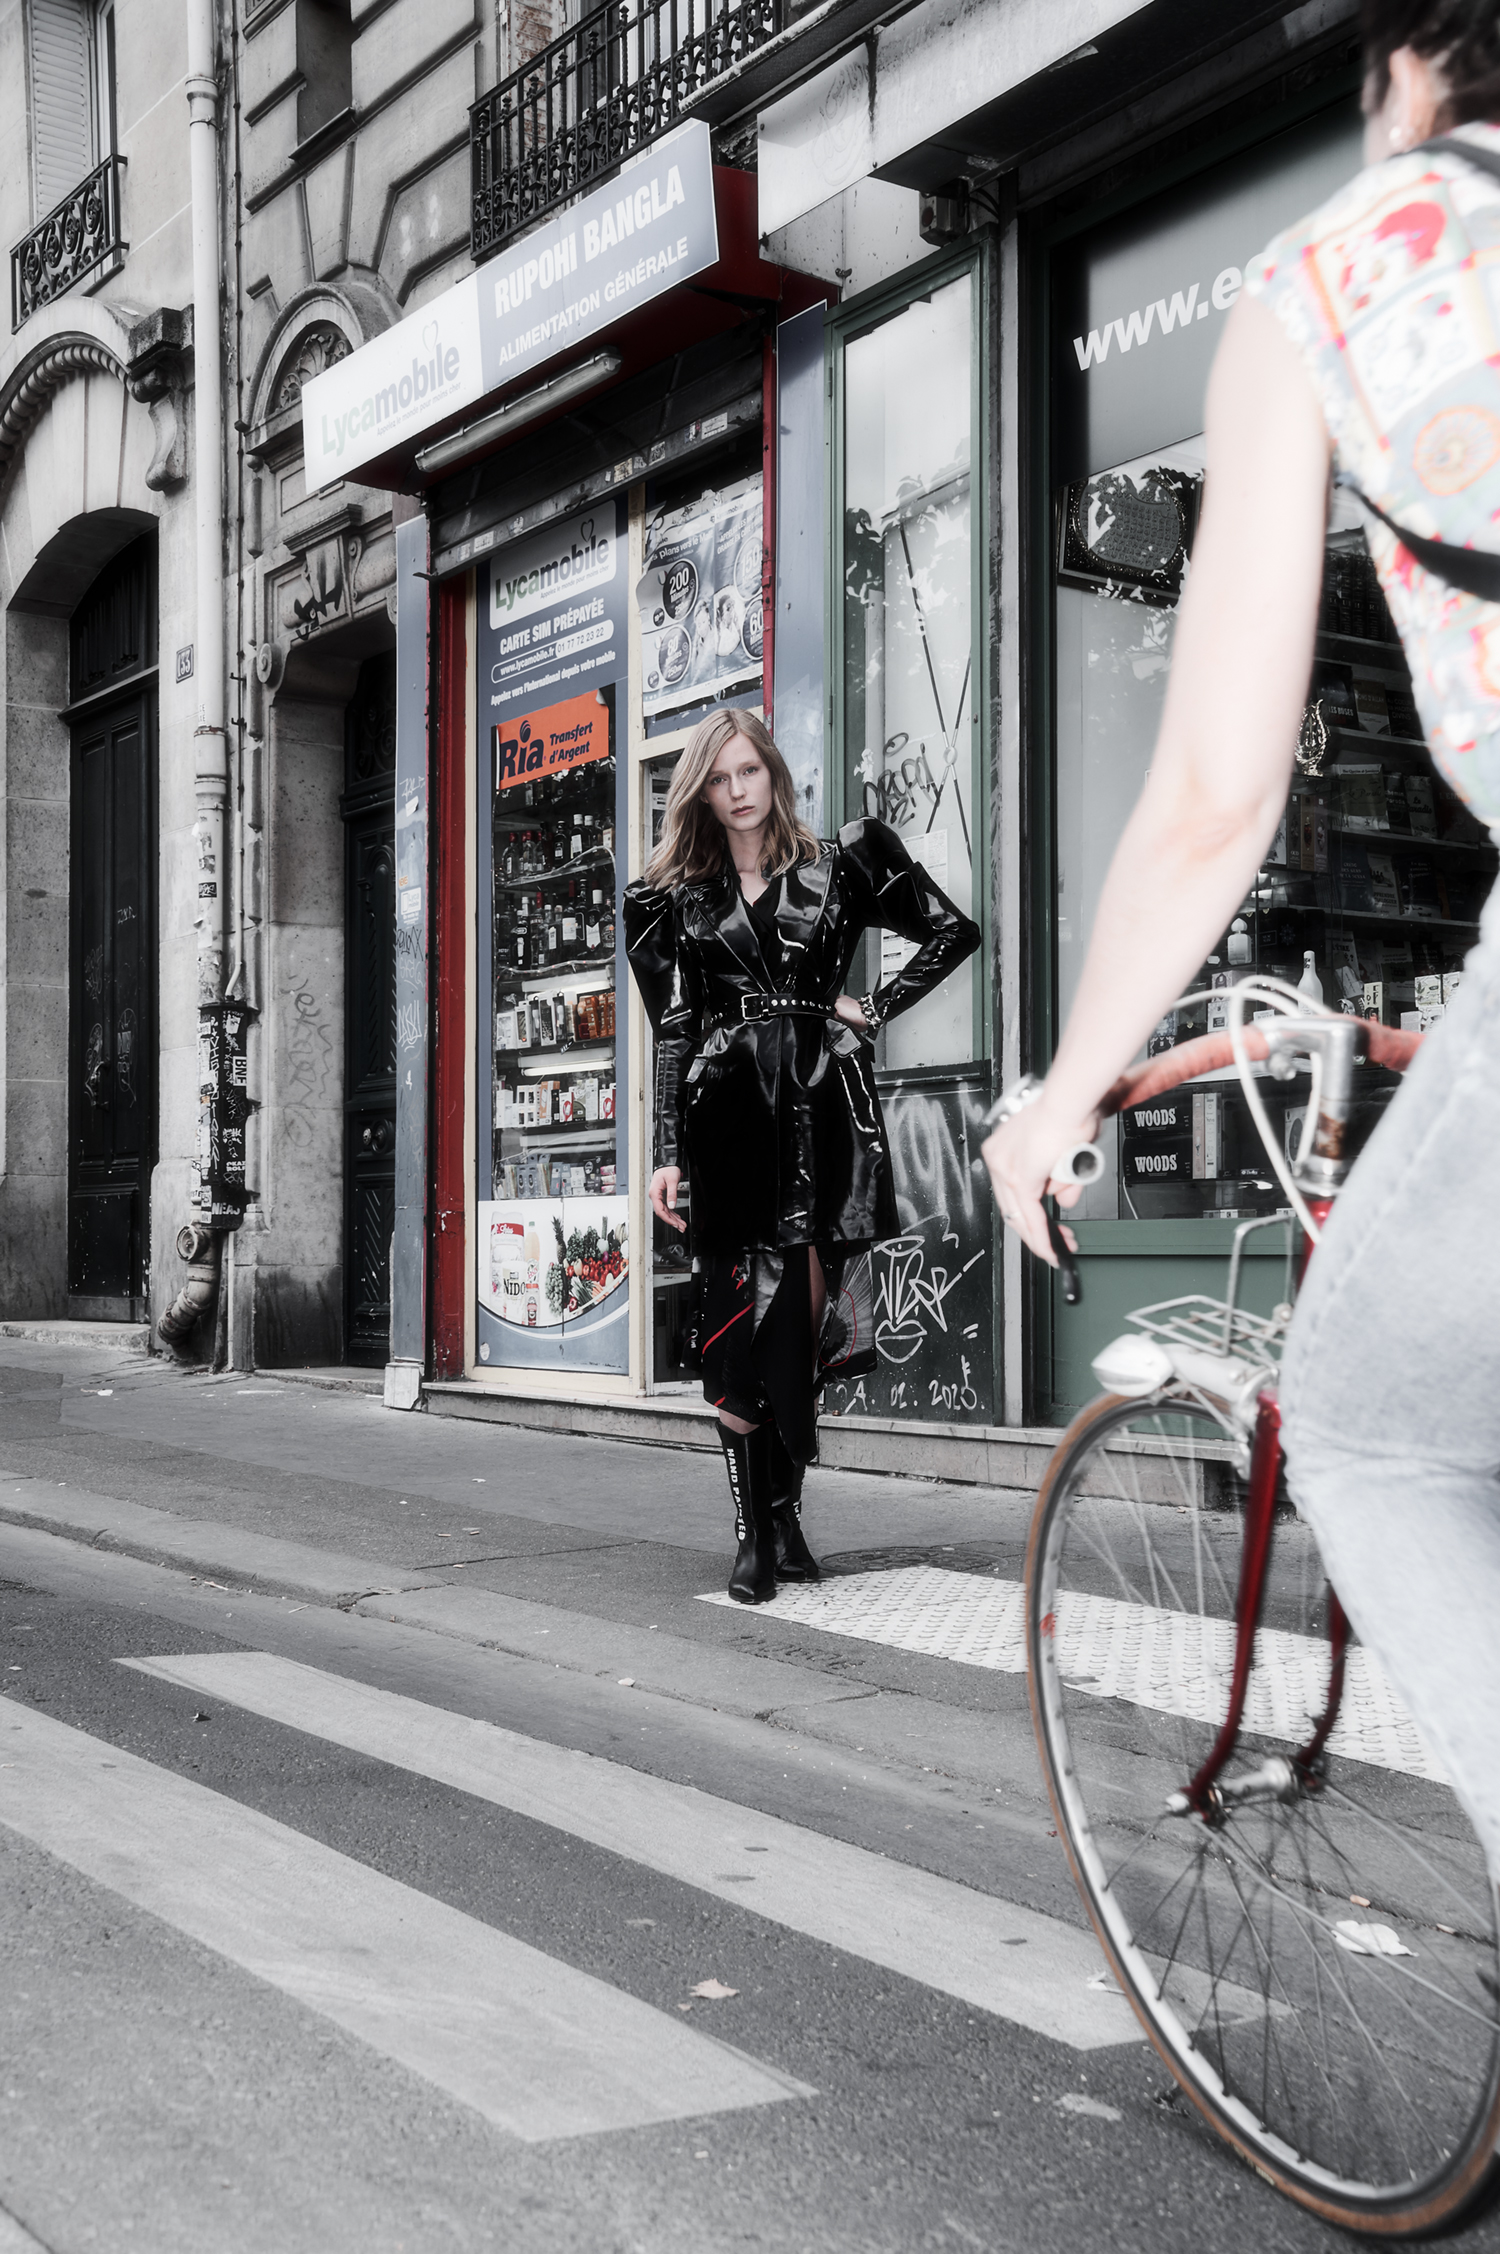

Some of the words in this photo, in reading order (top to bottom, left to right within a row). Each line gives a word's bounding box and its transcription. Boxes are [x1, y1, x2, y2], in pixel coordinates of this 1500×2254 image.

[494, 232, 578, 319] RUPOHI
[583, 165, 686, 263] BANGLA
[499, 290, 600, 366] ALIMENTATION
[604, 236, 689, 303] GÉNÉRALE
[321, 342, 460, 457] Lycamobile
[376, 419, 396, 437] Appelez
[401, 405, 419, 422] monde
[419, 400, 432, 415] pour
[432, 390, 448, 405] moins
[448, 381, 461, 395] cher
[659, 546, 680, 560] plans
[742, 544, 760, 577] 150
[495, 535, 610, 611] Lycamobile
[540, 587, 557, 600] Appelez
[561, 580, 575, 590] monde
[575, 575, 586, 586] pour
[586, 571, 599, 580] moins
[600, 565, 609, 574] cher
[669, 567, 689, 595] 200
[500, 628, 531, 656] CARTE
[532, 620, 551, 643] SIM
[553, 597, 605, 634] PRÉPAYÉE
[176, 652, 192, 678] 133
[500, 647, 555, 676] www.lycamobile.fr
[557, 643, 565, 653] 01
[567, 640, 575, 649] 77
[576, 636, 585, 645] 72
[586, 631, 595, 641] 23
[595, 627, 604, 638] 22
[490, 690, 511, 707] Appelez
[511, 685, 524, 698] vers
[561, 663, 580, 680] depuis
[580, 658, 595, 672] votre
[595, 650, 616, 666] mobile
[500, 720, 544, 781] Ria
[549, 721, 593, 746] Transfert
[549, 741, 590, 765] d'Argent
[1134, 1107, 1177, 1128] WOODS
[1134, 1153, 1178, 1173] WOODS
[503, 1278, 526, 1296] NIDO
[726, 1448, 738, 1483] HAND
